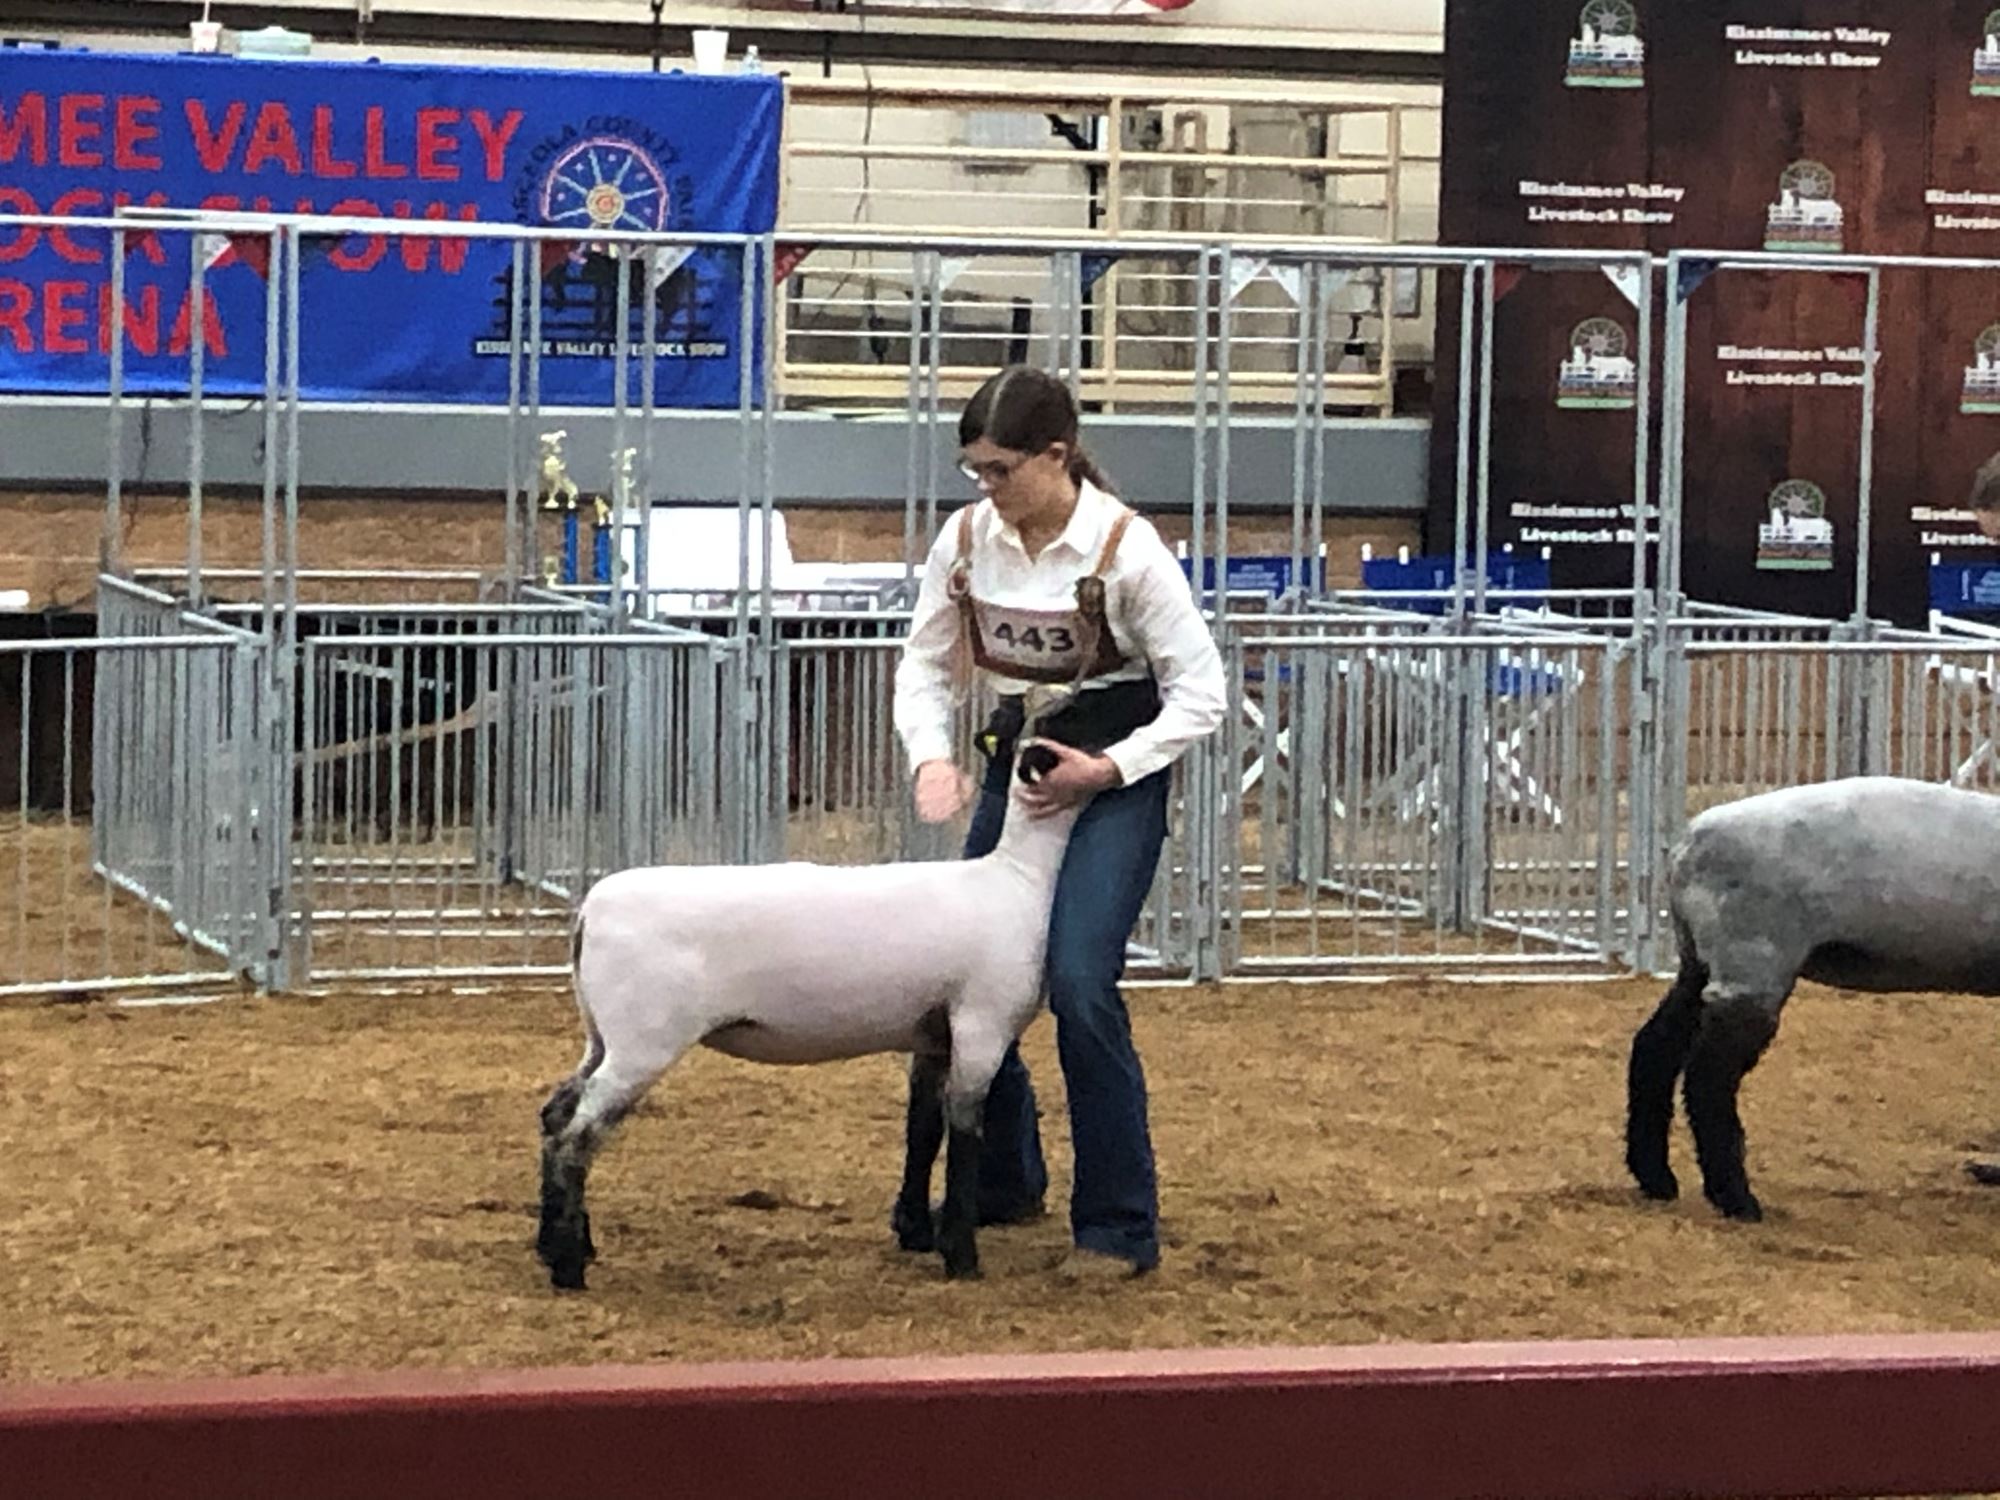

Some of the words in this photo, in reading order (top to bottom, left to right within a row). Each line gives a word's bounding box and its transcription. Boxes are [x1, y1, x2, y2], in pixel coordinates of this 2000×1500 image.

[0, 91, 163, 170] MEE
[184, 98, 524, 182] VALLEY
[200, 195, 478, 274] OW
[0, 278, 229, 358] RENA
[993, 622, 1075, 653] 443
